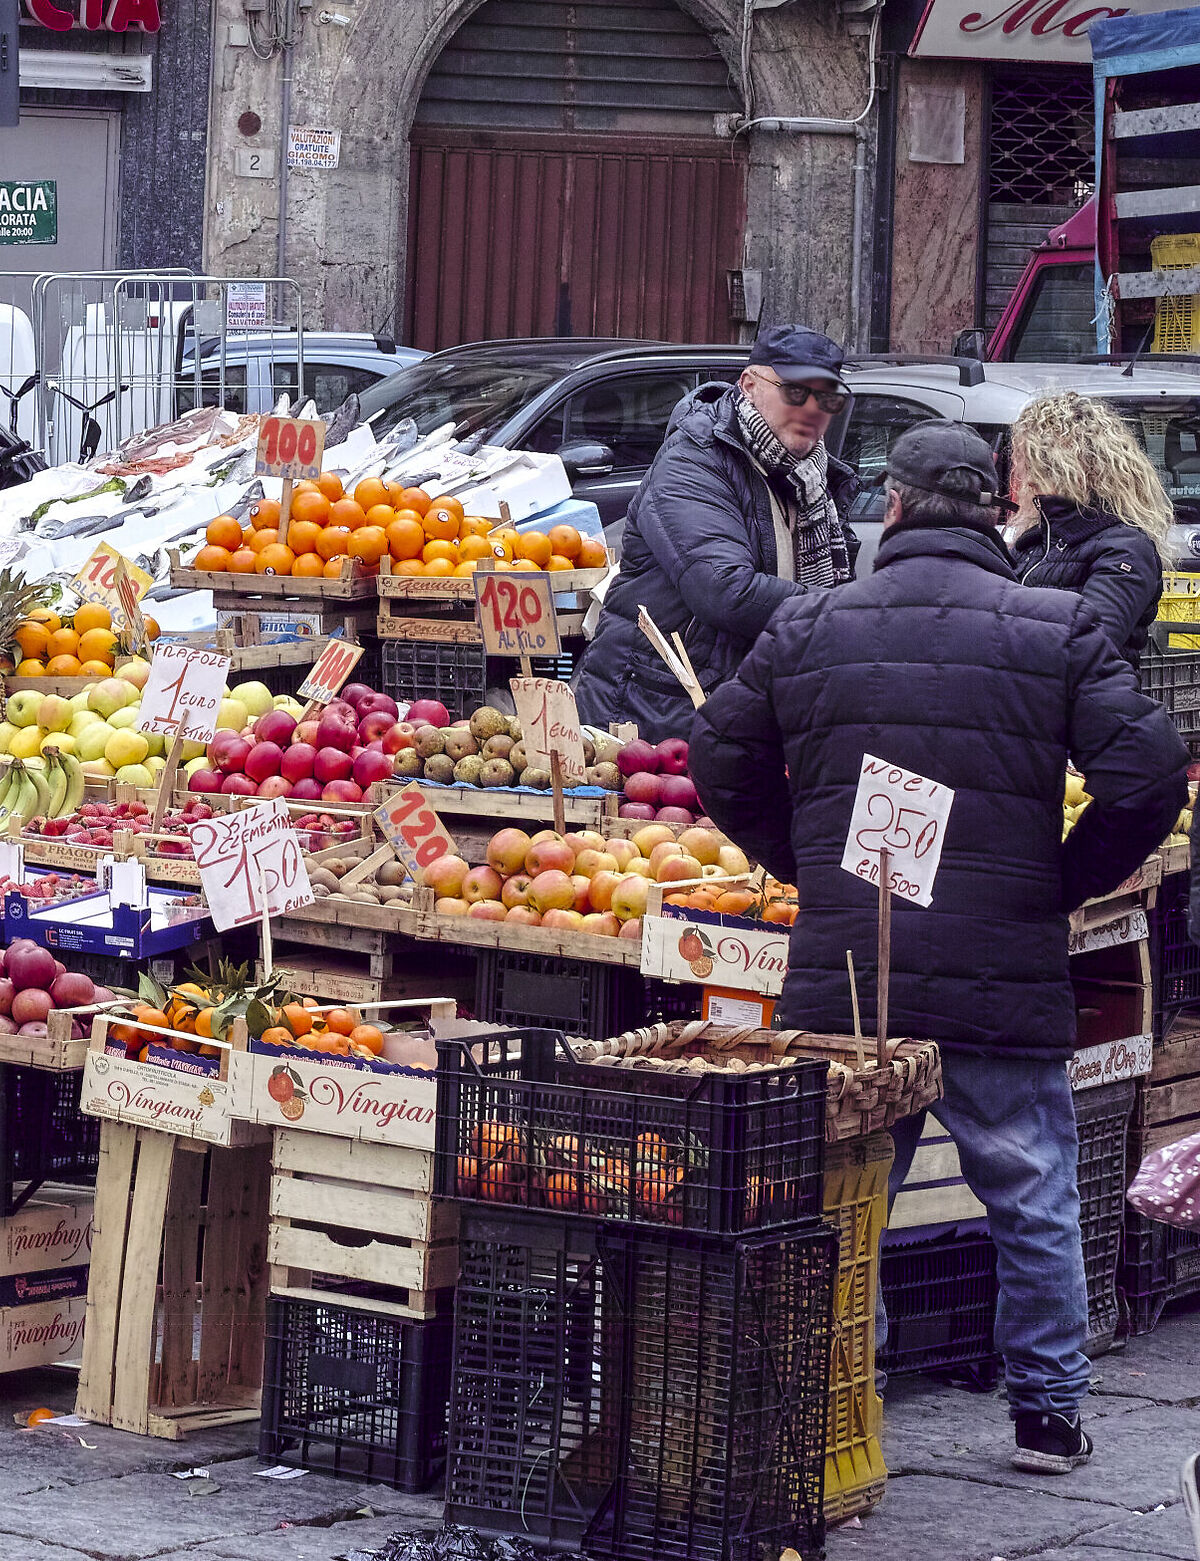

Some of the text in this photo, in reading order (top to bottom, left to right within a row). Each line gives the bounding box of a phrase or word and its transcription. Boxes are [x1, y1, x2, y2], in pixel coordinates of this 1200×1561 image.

[290, 133, 335, 145] VALUTAZIONI
[294, 143, 329, 153] GRATUITE
[250, 154, 260, 170] 2
[288, 150, 335, 160] GIACOMO
[12, 227, 33, 236] 20:00
[499, 628, 546, 648] AL KILO
[155, 643, 227, 668] FRAGOLE
[154, 662, 216, 725] 1 EURO
[531, 692, 580, 756] 1 EURO
[189, 823, 238, 870] 2
[886, 871, 920, 897] 500
[285, 895, 310, 911] EURO
[107, 1081, 203, 1121] Vingiani
[15, 1219, 94, 1261] Vingiani
